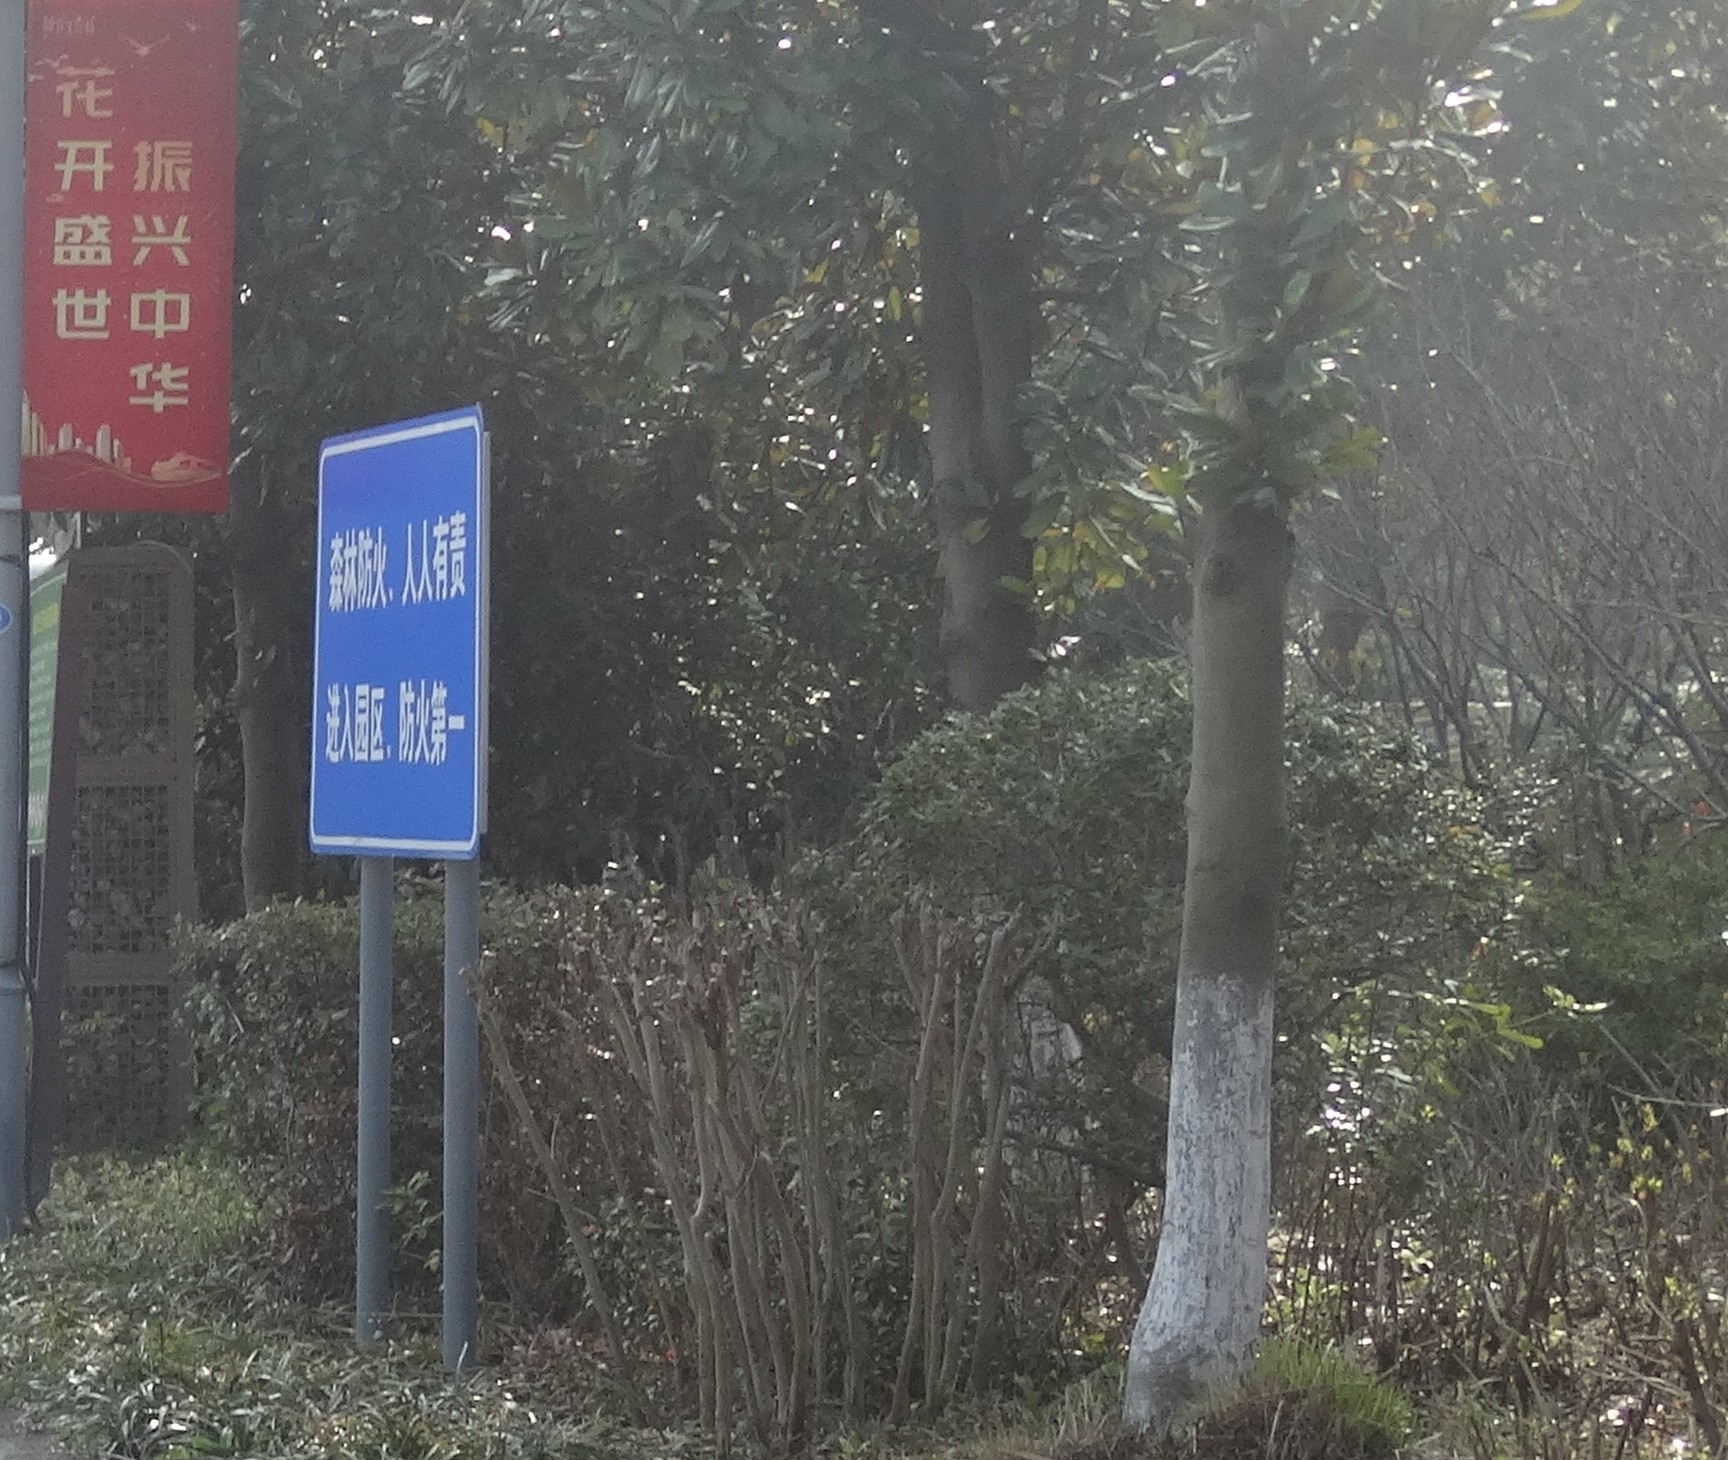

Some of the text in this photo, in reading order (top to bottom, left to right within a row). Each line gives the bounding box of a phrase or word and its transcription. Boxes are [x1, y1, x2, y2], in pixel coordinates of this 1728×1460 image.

[53, 66, 114, 340] 花开盛世
[130, 140, 192, 412] 振兴中华
